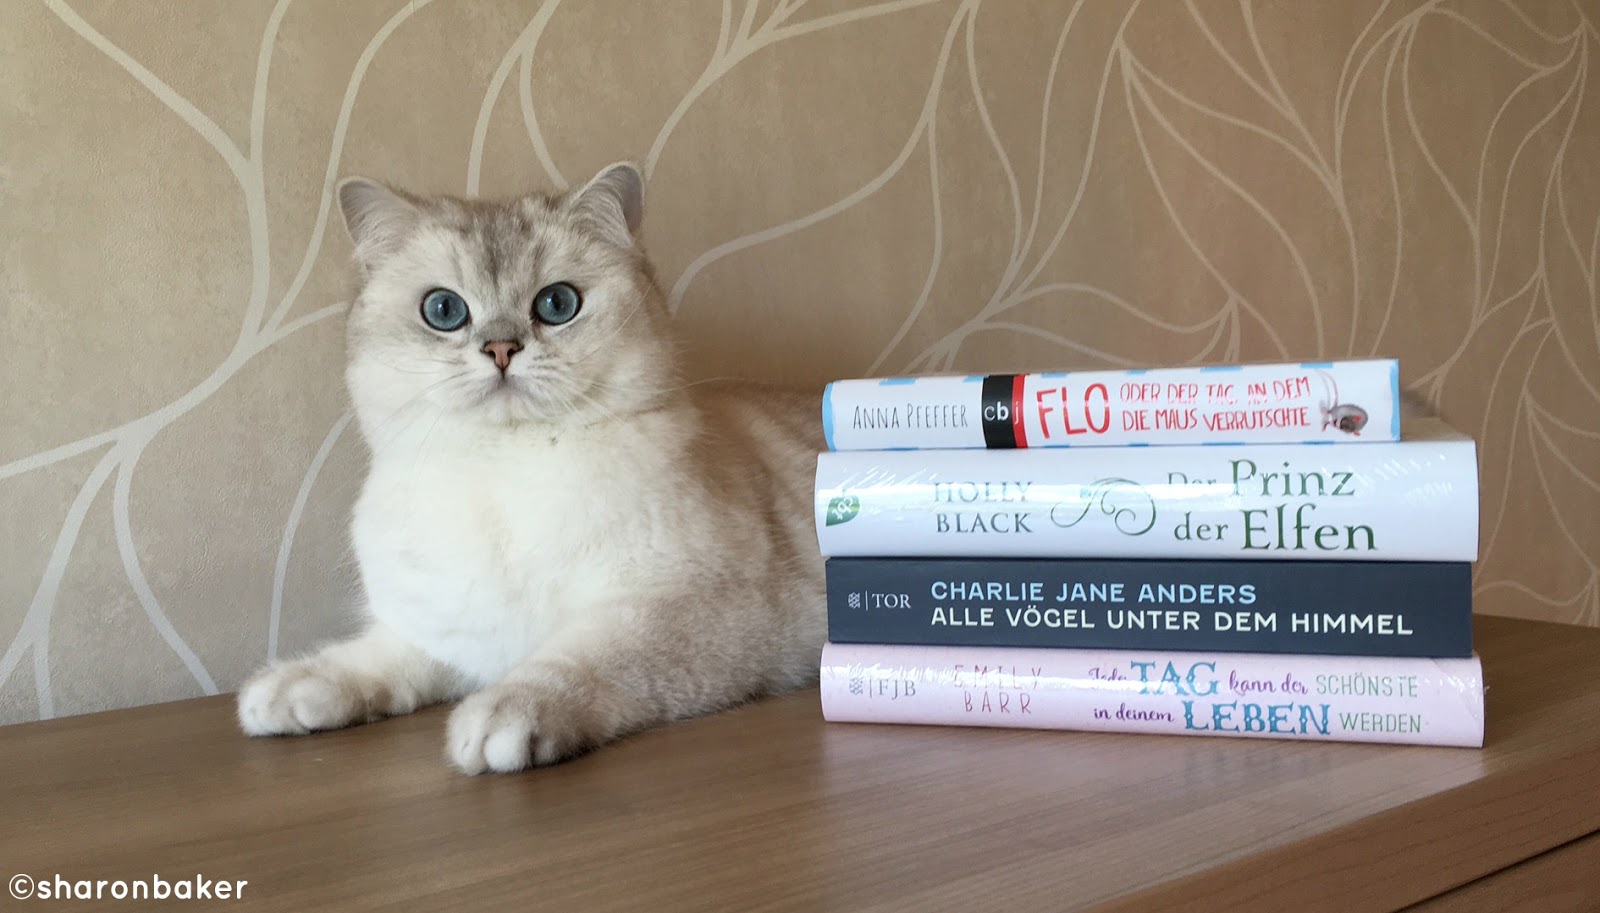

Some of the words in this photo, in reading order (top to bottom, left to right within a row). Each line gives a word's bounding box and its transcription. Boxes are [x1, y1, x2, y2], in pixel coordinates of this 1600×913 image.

[1120, 383, 1161, 403] ODER
[1167, 383, 1198, 404] DER
[1248, 382, 1267, 406] AN
[1273, 376, 1311, 401] DEM
[853, 404, 900, 430] ANNA
[906, 402, 968, 429] PFEFFER
[1036, 383, 1111, 439] FLO
[1122, 409, 1150, 431] DIE
[1155, 408, 1198, 431] MAUS
[1203, 406, 1311, 431] VERRUTSCHTE
[1228, 458, 1356, 497] Prinz
[933, 481, 1032, 503] HOLLY
[936, 512, 1034, 533] BLACK
[1174, 511, 1229, 540] der
[1240, 502, 1379, 551] Elfen
[871, 593, 912, 609] TOR
[931, 581, 1044, 602] CHARLIE
[1056, 582, 1125, 603] JANE
[1138, 584, 1257, 604] ANDERS
[931, 607, 995, 627] ALLE
[1005, 604, 1096, 629] VÖGEL
[1107, 610, 1201, 631] UNTER
[1214, 611, 1277, 632] DEM
[1291, 613, 1414, 635] HIMMEL
[878, 679, 917, 699] FJB
[954, 664, 1042, 689] EMILY
[1130, 660, 1219, 697] TAG
[1229, 669, 1277, 697] kann
[1281, 672, 1309, 695] der
[1316, 672, 1418, 698] SCHÖNSTE
[964, 690, 1032, 714] BARR
[1093, 708, 1112, 721] in
[1115, 702, 1175, 723] deinem
[1182, 700, 1332, 736] LEBEN
[1339, 712, 1422, 733] WERDEN
